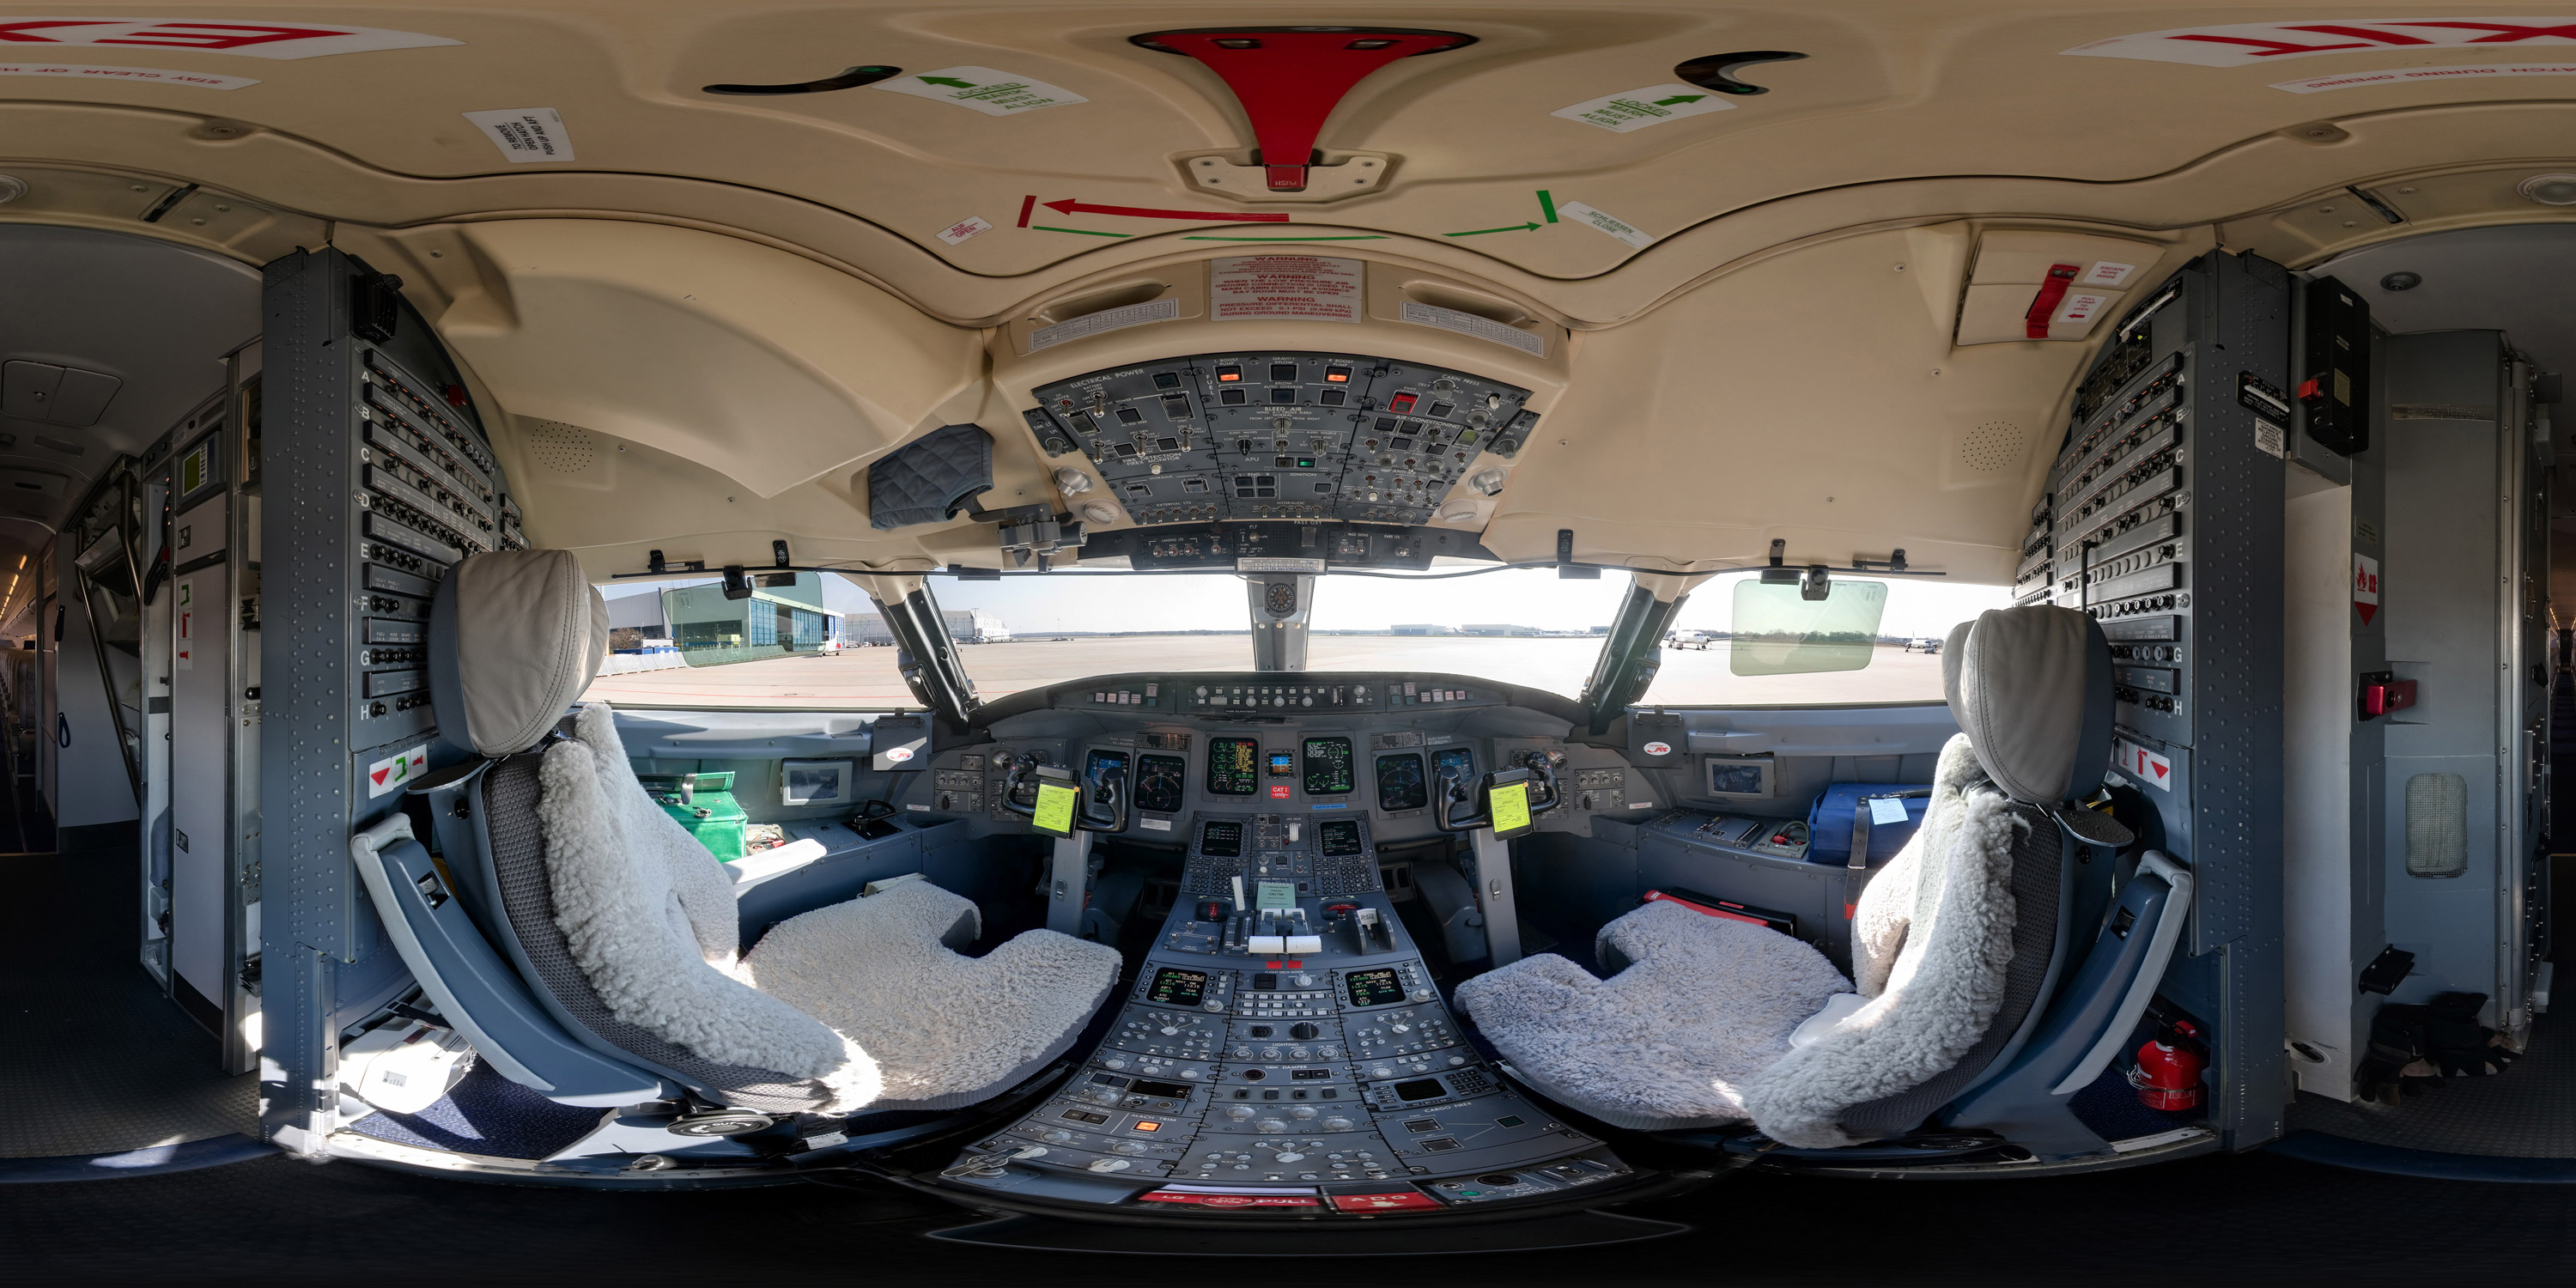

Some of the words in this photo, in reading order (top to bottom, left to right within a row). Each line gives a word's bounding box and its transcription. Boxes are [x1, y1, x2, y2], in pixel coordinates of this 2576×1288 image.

[82, 69, 160, 78] CLEAR
[2405, 66, 2497, 78] DURING
[171, 75, 224, 84] STAY
[2306, 73, 2397, 89] OPENING
[947, 81, 1022, 98] LOCKED
[975, 89, 1025, 101] MARK
[990, 93, 1038, 105] MUST
[1004, 98, 1055, 110] ALIGN
[1606, 105, 1651, 118] MARK
[1615, 98, 1673, 116] LOCKED
[523, 116, 539, 125] AFT
[1578, 112, 1622, 126] ALIGN
[1594, 109, 1635, 121] MUST
[494, 124, 517, 144] REMOVE
[511, 122, 529, 138] HATCH
[531, 125, 546, 135] AND
[524, 138, 538, 150] OPEN
[543, 143, 555, 155] PUSH
[950, 223, 966, 232] AUF
[1589, 211, 1634, 234] SCHLIESSEN
[1592, 220, 1618, 233] CLOSE
[955, 226, 976, 238] OPEN
[361, 371, 370, 382] A
[1070, 374, 1112, 388] ELECTRICAL
[1114, 369, 1145, 378] POWER
[2177, 373, 2185, 385] A
[361, 406, 370, 420] B
[2176, 410, 2184, 422] B
[361, 447, 370, 461] C
[1140, 453, 1181, 461] DETECTION
[2175, 449, 2184, 462] C
[361, 493, 369, 508] D
[2175, 494, 2183, 509] D
[361, 543, 369, 559] E
[2175, 542, 2183, 557] E
[361, 596, 368, 611] F
[2175, 594, 2182, 609] F
[360, 651, 370, 666] G
[2173, 647, 2182, 663] G
[361, 705, 369, 721] H
[2174, 700, 2182, 716] H
[1424, 1105, 1451, 1113] CARGO
